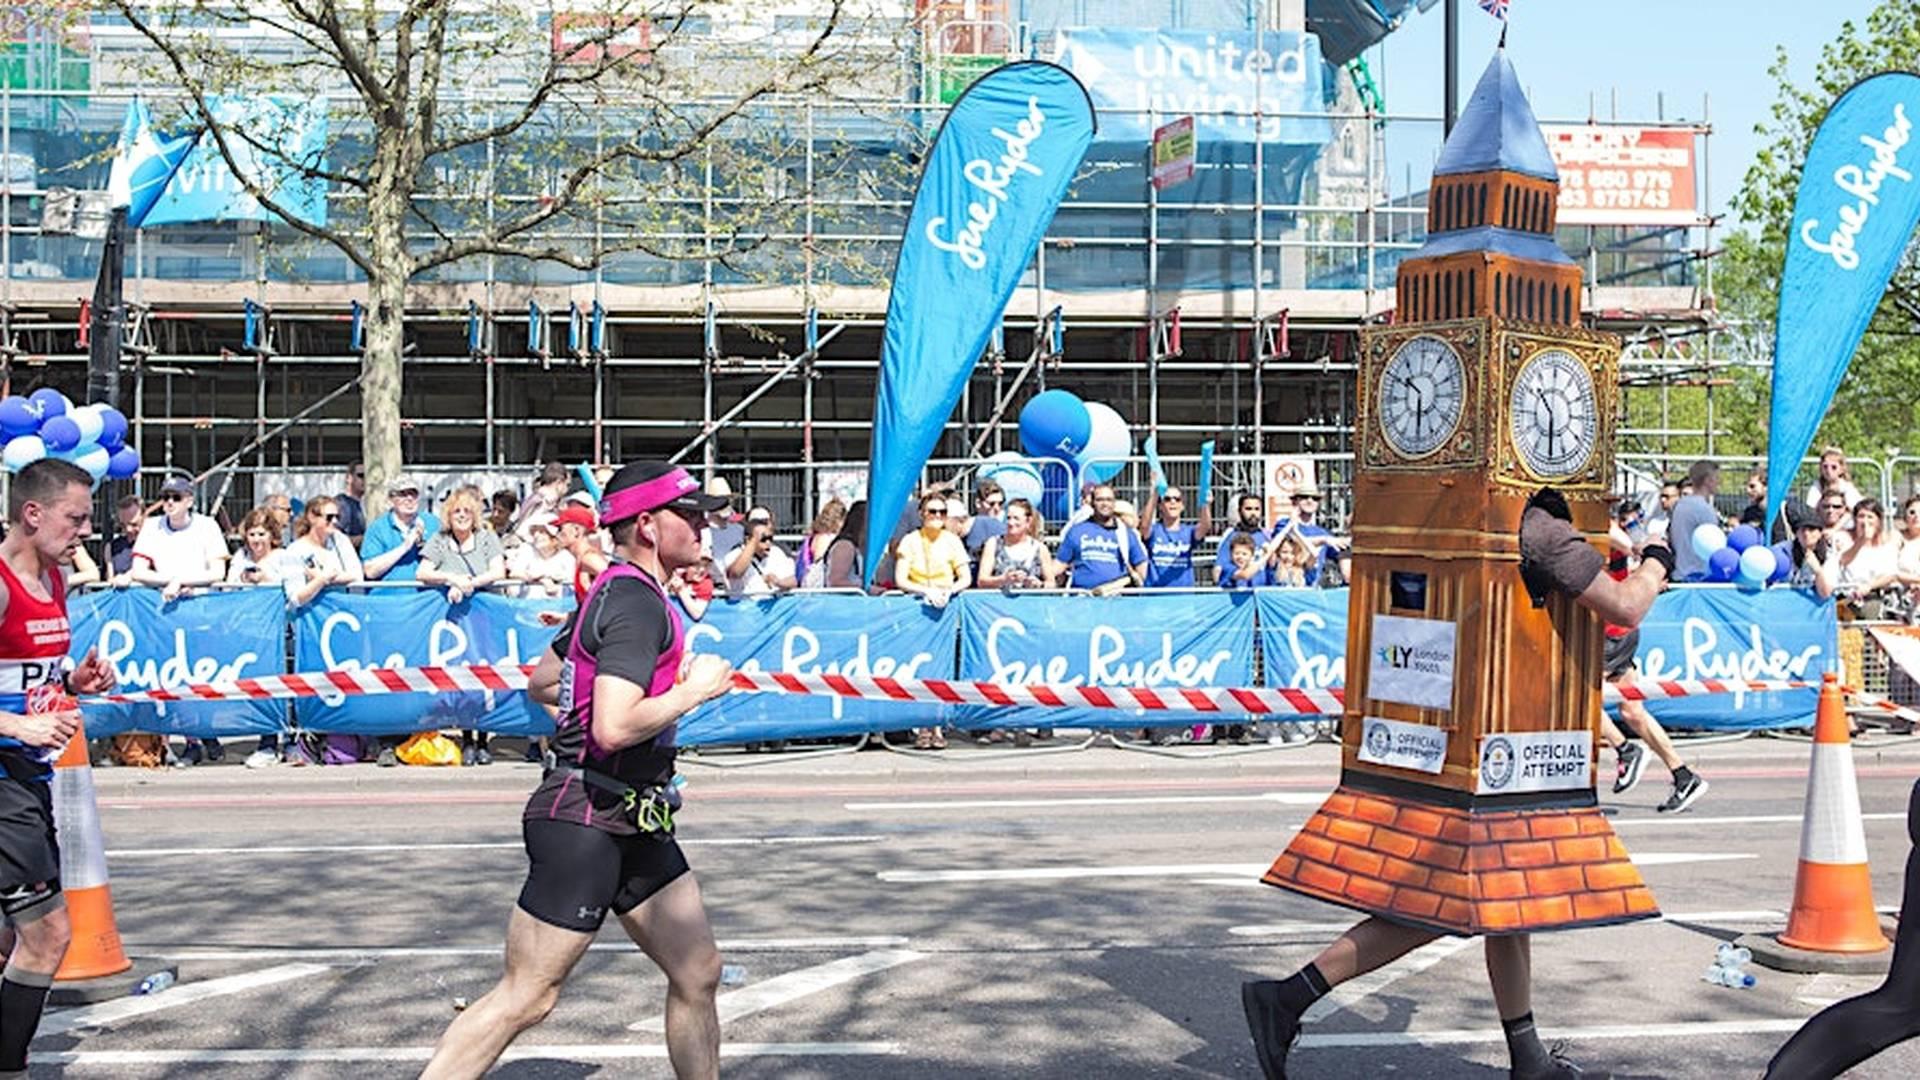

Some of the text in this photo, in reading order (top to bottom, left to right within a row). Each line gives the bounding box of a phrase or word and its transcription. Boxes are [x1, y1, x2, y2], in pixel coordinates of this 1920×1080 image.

[1135, 34, 1307, 84] united
[1136, 80, 1281, 141] living
[925, 95, 1046, 270] Sue Ryder
[1801, 102, 1913, 270] Sue Ryder
[99, 619, 258, 717] Ryder
[986, 617, 1232, 715] Sue Ryder
[1288, 611, 1346, 690] Su
[1393, 645, 1413, 669] LY
[1683, 617, 1821, 710] Ryder
[1396, 746, 1441, 761] ATTEMPT
[1398, 733, 1442, 750] OFFICIAL
[1522, 761, 1586, 778] ATTEMPT
[1523, 744, 1586, 760] OFFICIAL
